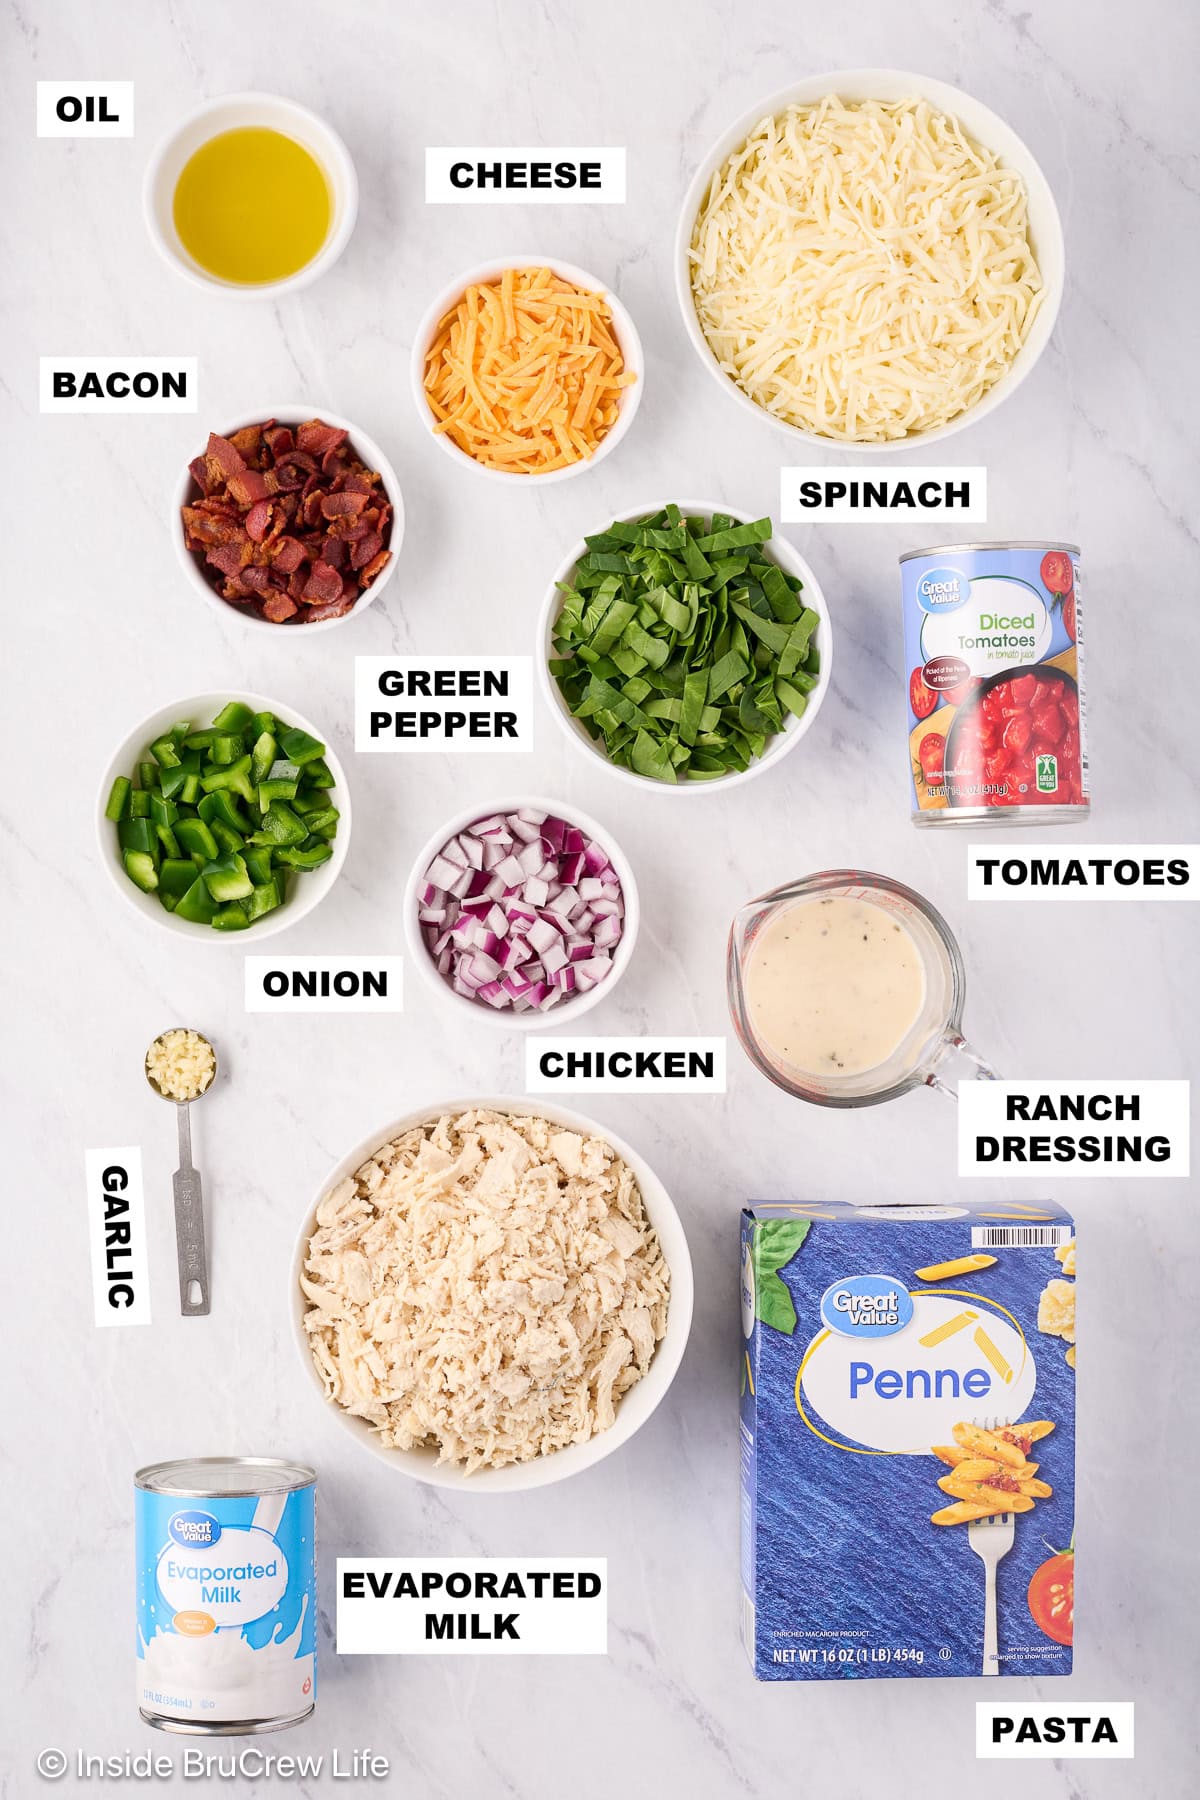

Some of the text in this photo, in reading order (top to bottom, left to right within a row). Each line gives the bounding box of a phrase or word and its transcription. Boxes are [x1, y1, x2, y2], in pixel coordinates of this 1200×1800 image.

[921, 579, 959, 596] Great
[929, 593, 960, 605] Value
[980, 613, 1034, 630] Diced
[958, 634, 1035, 649] Tomatoes
[995, 650, 1019, 659] tomato
[928, 788, 938, 797] NET
[980, 783, 1009, 796] (411g)
[832, 1290, 898, 1312] Great
[848, 1310, 898, 1325] Value
[850, 1362, 991, 1399] Penne
[174, 1518, 212, 1533] Great
[183, 1531, 212, 1542] Value
[167, 1560, 277, 1584] Evaporated
[201, 1586, 241, 1603] Milk
[773, 1649, 924, 1663] NET WT 16 OZ (1 LB) 454g
